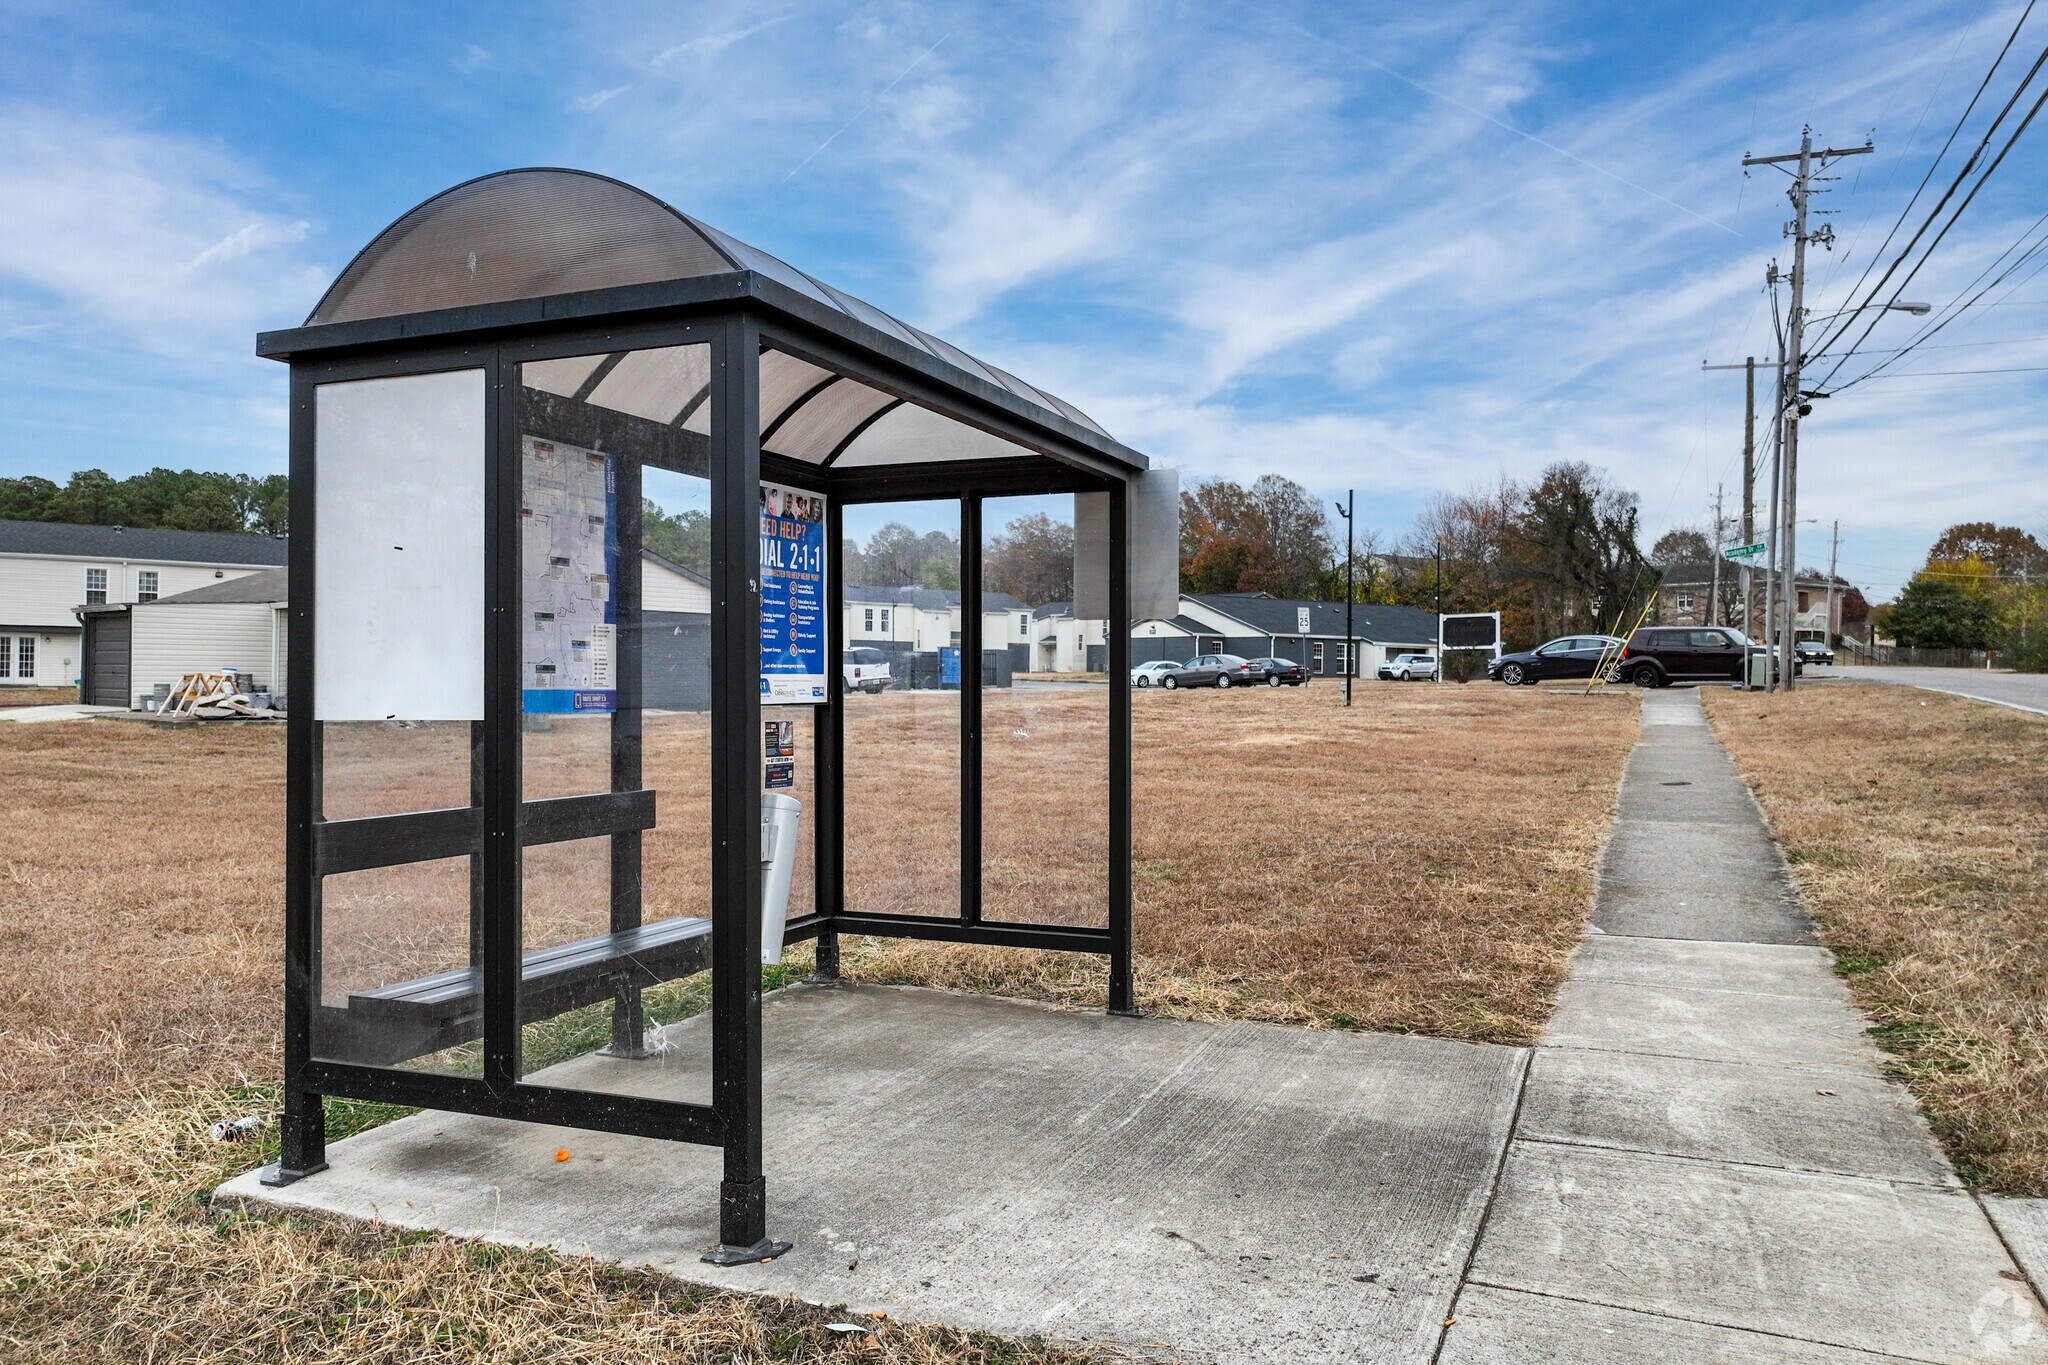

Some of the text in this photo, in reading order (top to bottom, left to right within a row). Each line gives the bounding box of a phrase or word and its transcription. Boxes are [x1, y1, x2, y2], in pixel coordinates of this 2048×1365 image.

[760, 517, 806, 541] EED HELP?
[791, 571, 800, 579] HELP
[1300, 618, 1308, 626] 25
